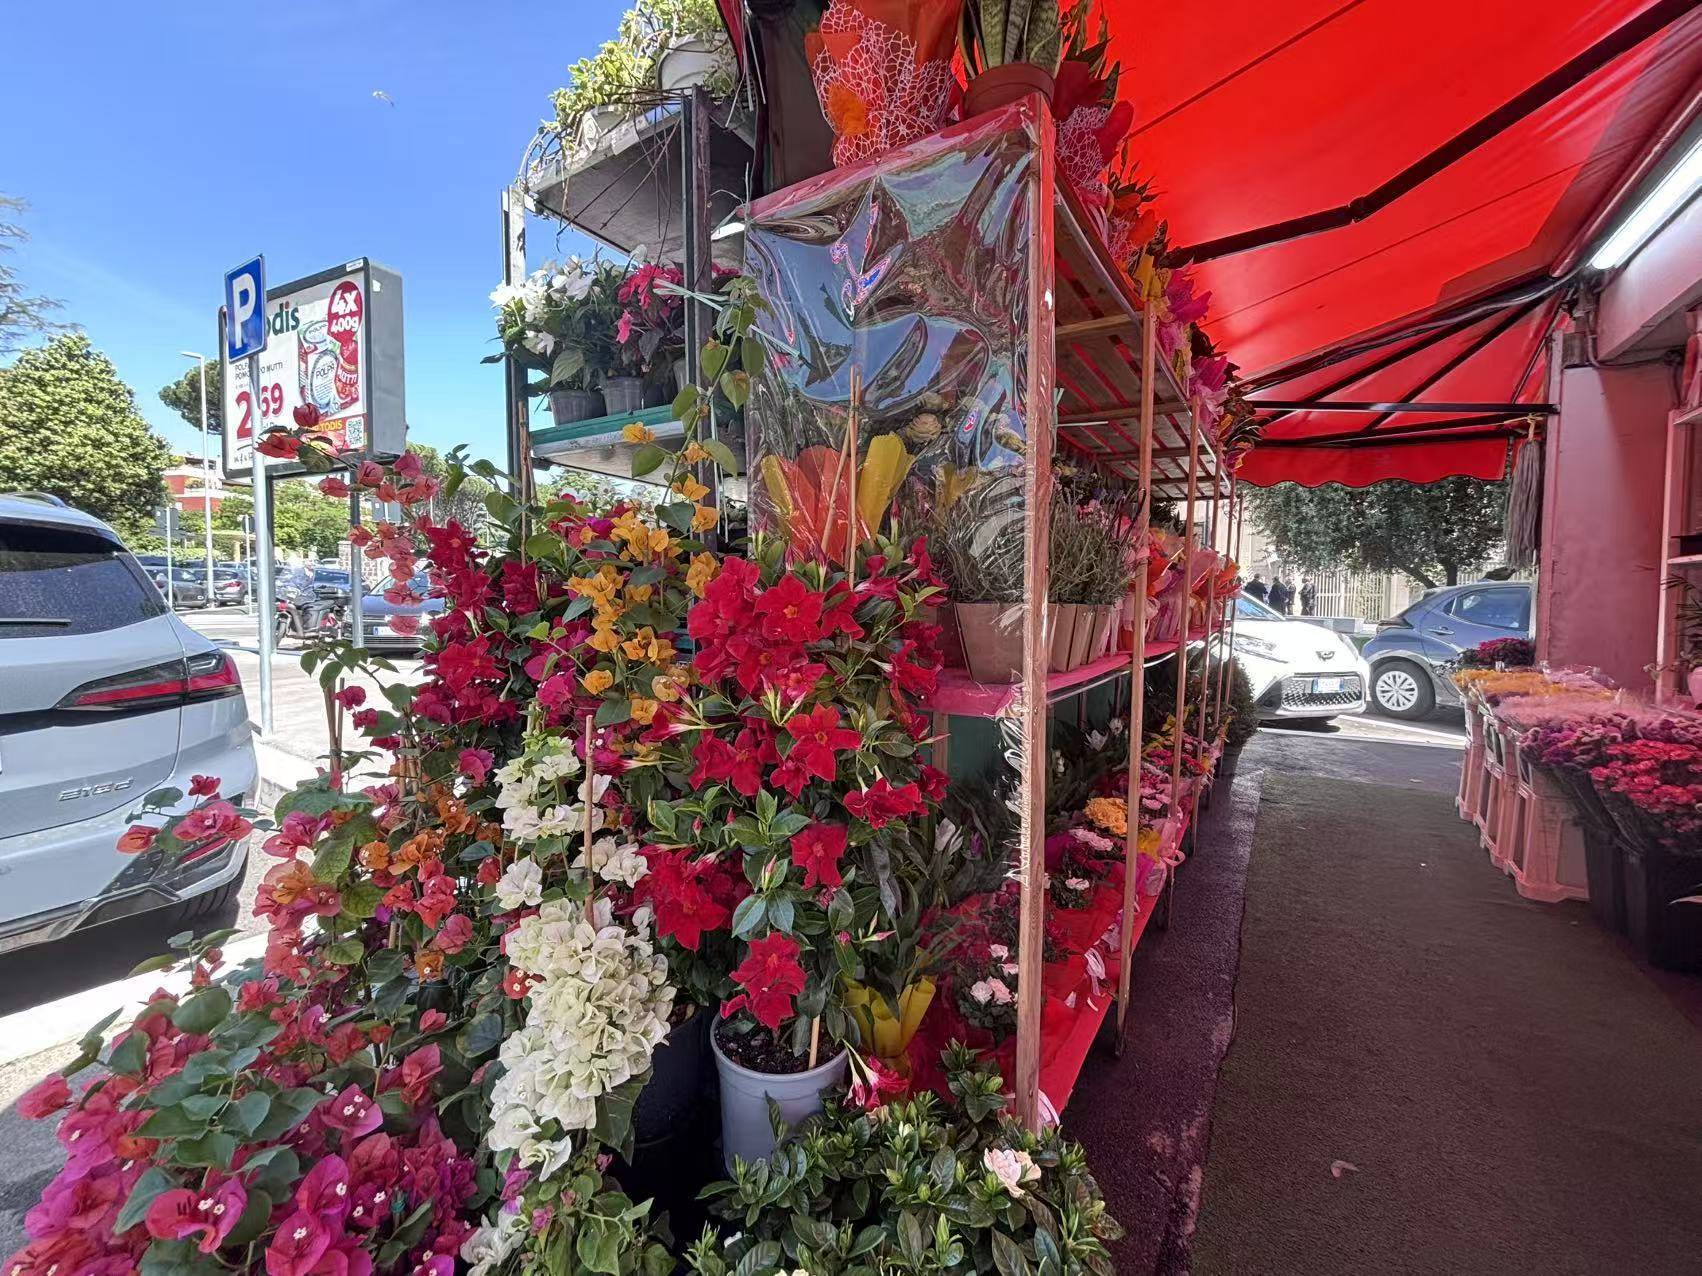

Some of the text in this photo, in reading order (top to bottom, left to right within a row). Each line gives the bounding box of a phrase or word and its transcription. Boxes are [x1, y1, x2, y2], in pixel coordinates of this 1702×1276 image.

[232, 272, 256, 350] P
[266, 301, 300, 338] dis
[330, 315, 359, 333] 400g
[266, 361, 283, 373] MUTTI
